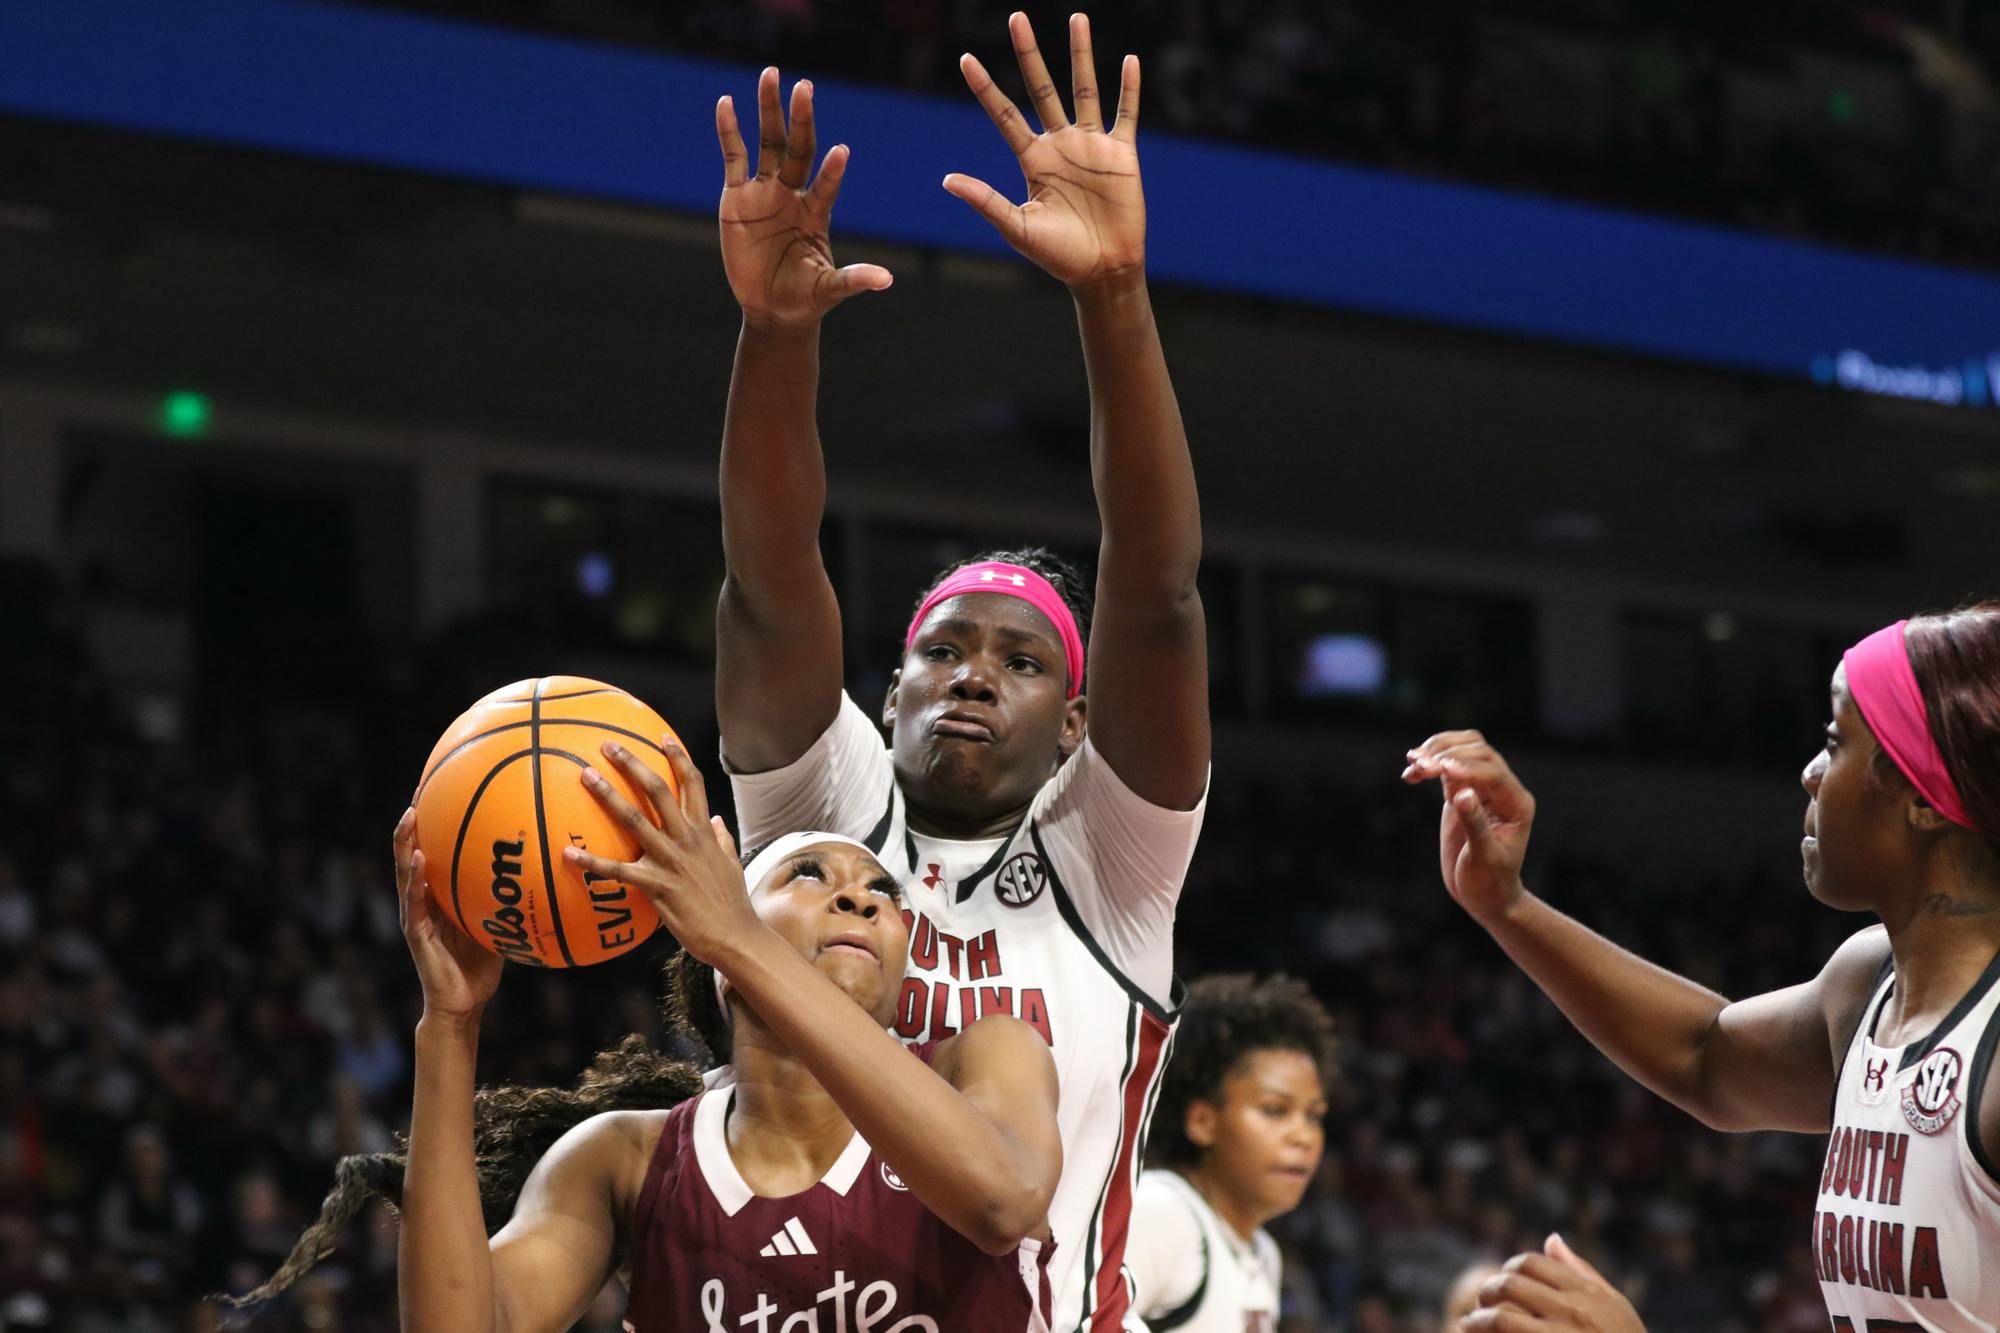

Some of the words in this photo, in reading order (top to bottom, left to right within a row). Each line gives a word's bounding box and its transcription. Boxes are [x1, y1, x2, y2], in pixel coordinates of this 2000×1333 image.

[998, 854, 1043, 904] SEC
[902, 909, 1002, 981] UTH
[894, 976, 1053, 1047] OLINA
[1916, 1051, 1958, 1110] SEC
[1903, 1101, 1949, 1132] GRADUATE
[1822, 1126, 1909, 1206] SOUTH
